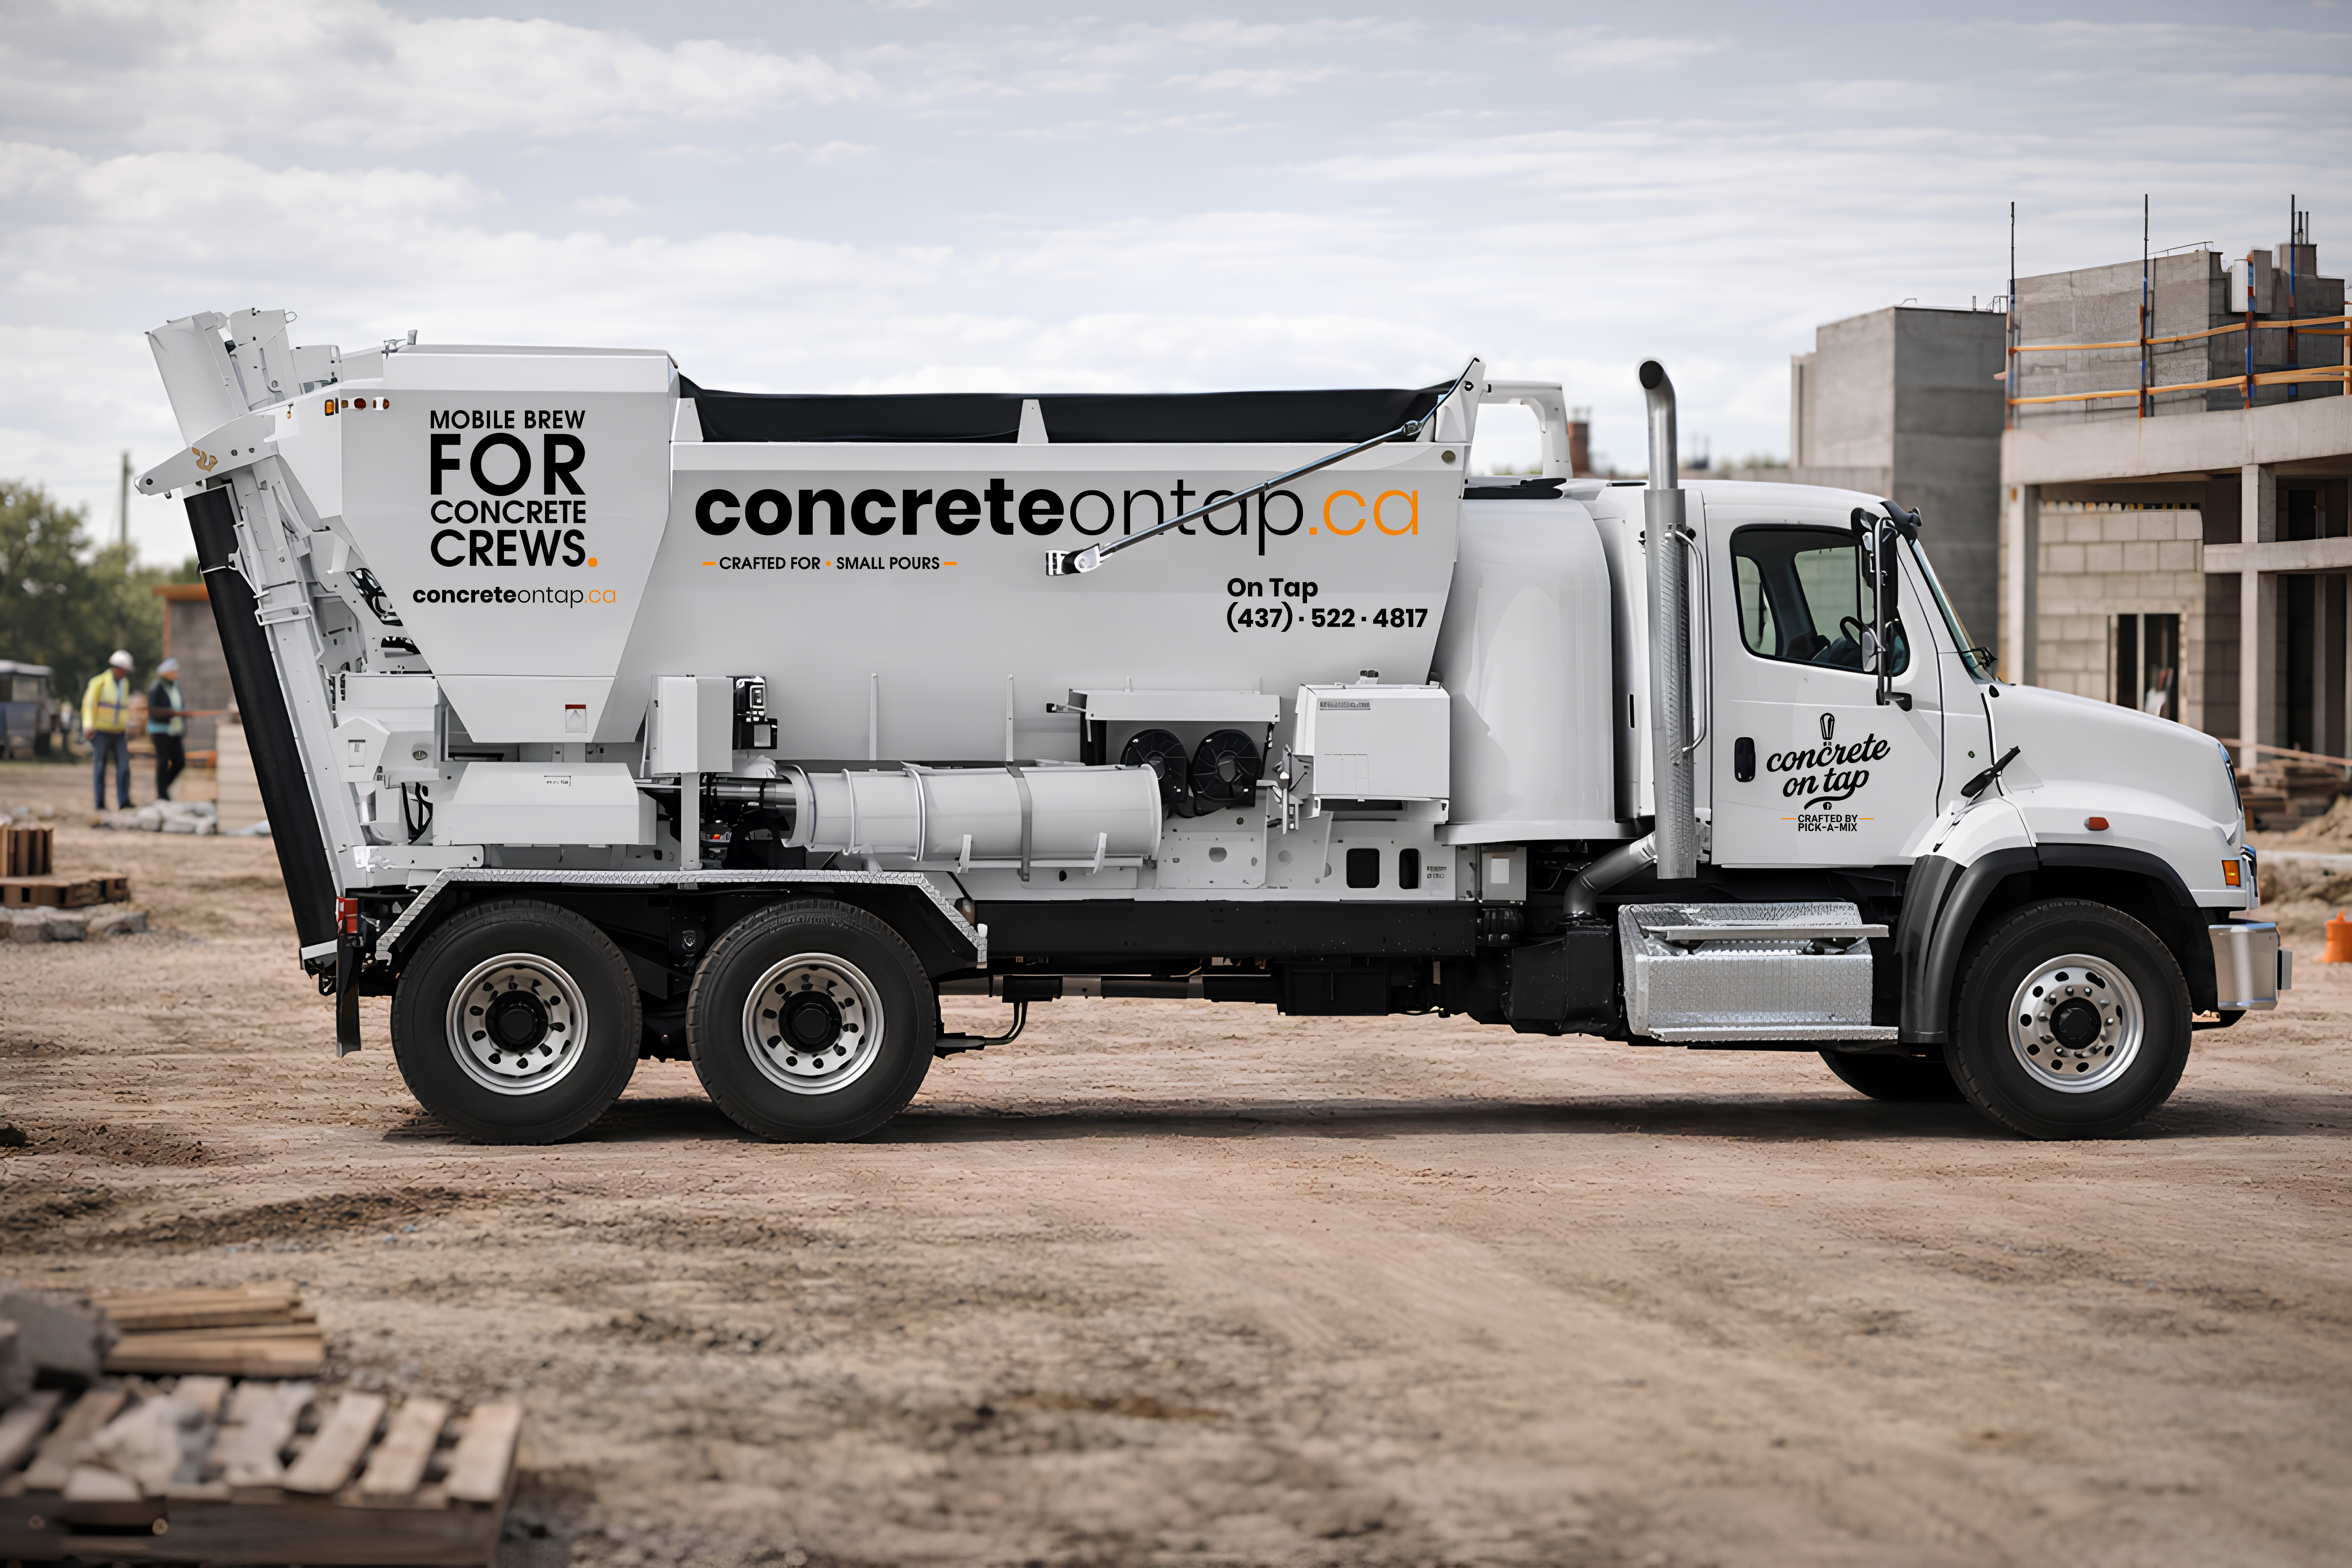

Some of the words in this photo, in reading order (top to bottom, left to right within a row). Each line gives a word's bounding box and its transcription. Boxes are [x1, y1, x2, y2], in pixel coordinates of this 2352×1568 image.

[431, 410, 514, 429] MOBILE
[525, 410, 585, 428] BREW
[431, 433, 585, 496] FOR
[431, 500, 586, 524] CONCRETE
[696, 479, 1418, 555] concreteontap.ca
[431, 529, 598, 567] CREWS.
[720, 557, 786, 569] CRAFTED
[791, 557, 820, 569] FOR
[837, 557, 885, 569] SMALL
[890, 557, 939, 569] POURS
[413, 587, 615, 608] concreteontap.ca
[1228, 578, 1262, 597] On
[1269, 578, 1318, 603] Tap
[1227, 602, 1292, 632] (437)
[1312, 609, 1355, 627] 522
[1373, 608, 1428, 627] 4817
[1767, 734, 1890, 772] concrete
[1783, 776, 1819, 797] on
[1821, 768, 1869, 801] tap
[1798, 815, 1842, 823] CRAFTED
